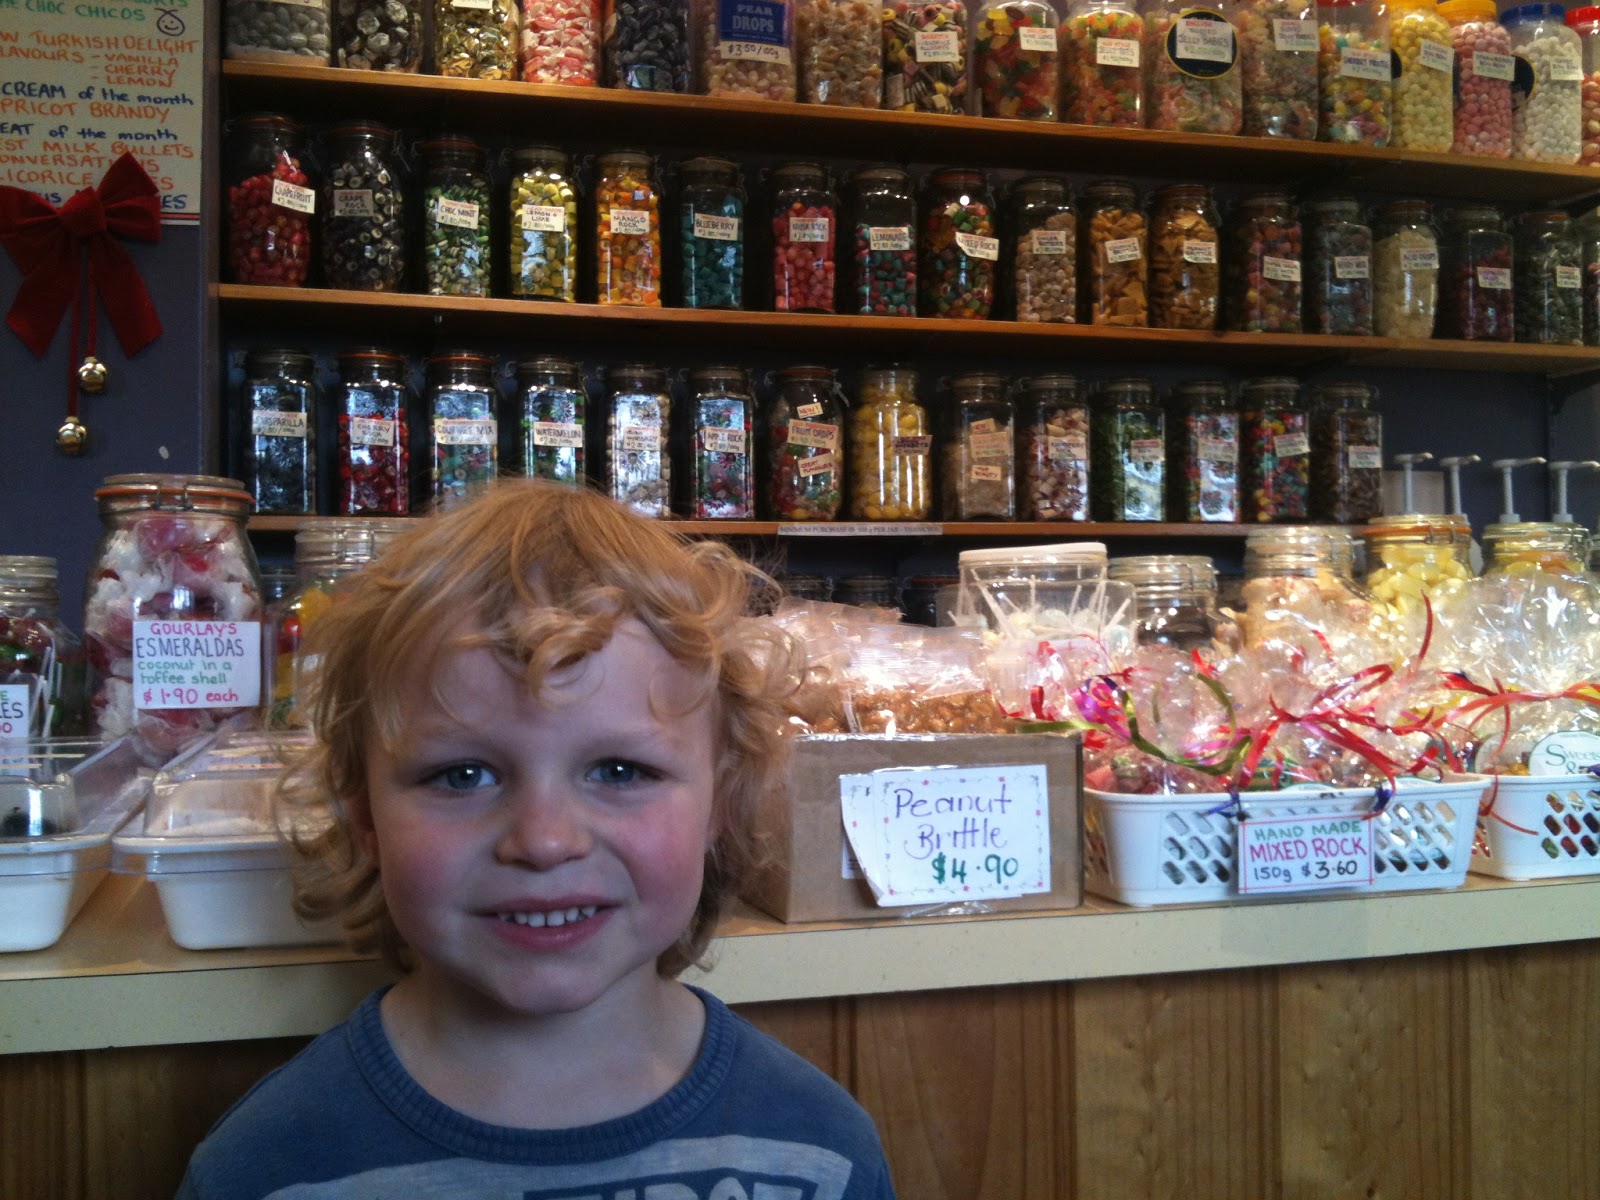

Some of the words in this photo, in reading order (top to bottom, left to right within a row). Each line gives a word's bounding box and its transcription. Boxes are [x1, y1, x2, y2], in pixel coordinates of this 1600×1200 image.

[75, 4, 146, 20] CHICOS
[737, 4, 774, 16] PEAR
[732, 15, 775, 33] DROPS
[28, 30, 119, 50] TURKISH
[104, 53, 179, 66] VANILLA
[104, 64, 176, 77] CHERRY
[106, 75, 175, 88] LEMON
[1, 81, 66, 99] CREAM
[78, 86, 95, 100] of
[102, 87, 130, 102] the
[137, 93, 194, 106] month
[90, 102, 170, 124] BRANDY
[49, 125, 69, 138] of
[77, 127, 107, 139] the
[118, 129, 178, 141] month
[43, 141, 98, 154] MILK
[613, 215, 647, 224] MANGO
[696, 220, 735, 230] BLUEBERRY
[358, 423, 391, 434] CHERRY
[536, 427, 581, 439] WATERMELON
[791, 425, 811, 436] FRUIT
[728, 433, 744, 443] ROCK
[136, 637, 244, 658] ESMERALDAS
[138, 659, 196, 670] coconut
[202, 660, 217, 671] in
[223, 661, 233, 671] a
[141, 671, 186, 684] toffee
[191, 671, 227, 684] shell
[206, 688, 239, 702] each
[894, 783, 1013, 819] Peanut
[1254, 825, 1305, 841] HAND
[1311, 820, 1363, 836] MADE
[903, 817, 1008, 860] Brittle
[1250, 839, 1309, 863] MIXED
[1311, 837, 1367, 858] ROCK
[1254, 865, 1292, 883] 150g
